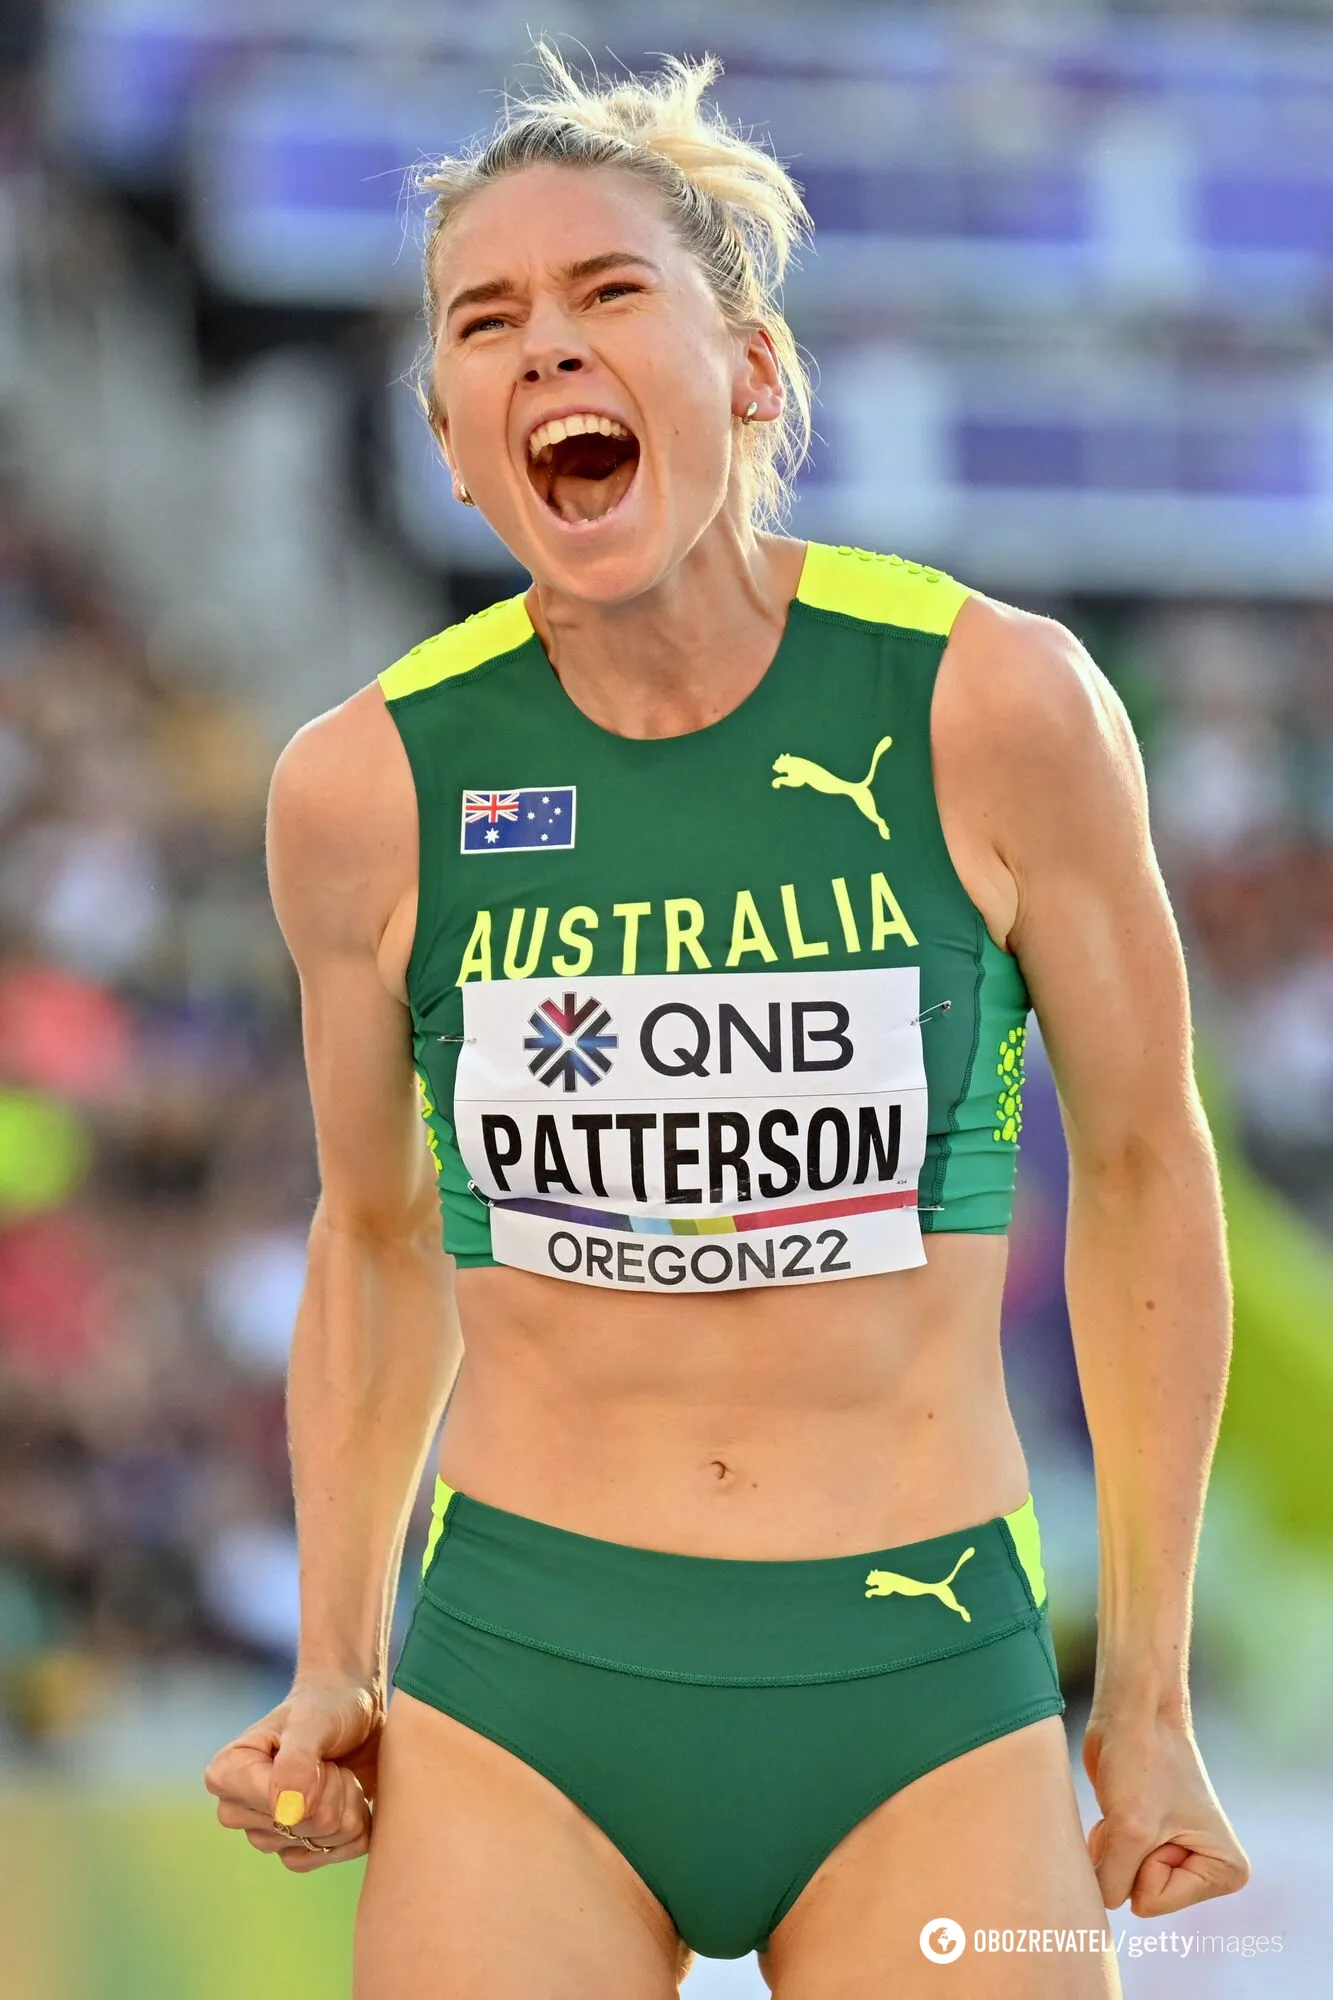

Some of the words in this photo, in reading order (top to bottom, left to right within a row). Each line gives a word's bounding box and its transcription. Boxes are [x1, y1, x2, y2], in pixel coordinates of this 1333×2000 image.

[456, 872, 919, 987] AUSTRALIA
[639, 1001, 854, 1077] QNB
[481, 1104, 902, 1204] PATTERSON
[547, 1229, 851, 1286] OREGON22
